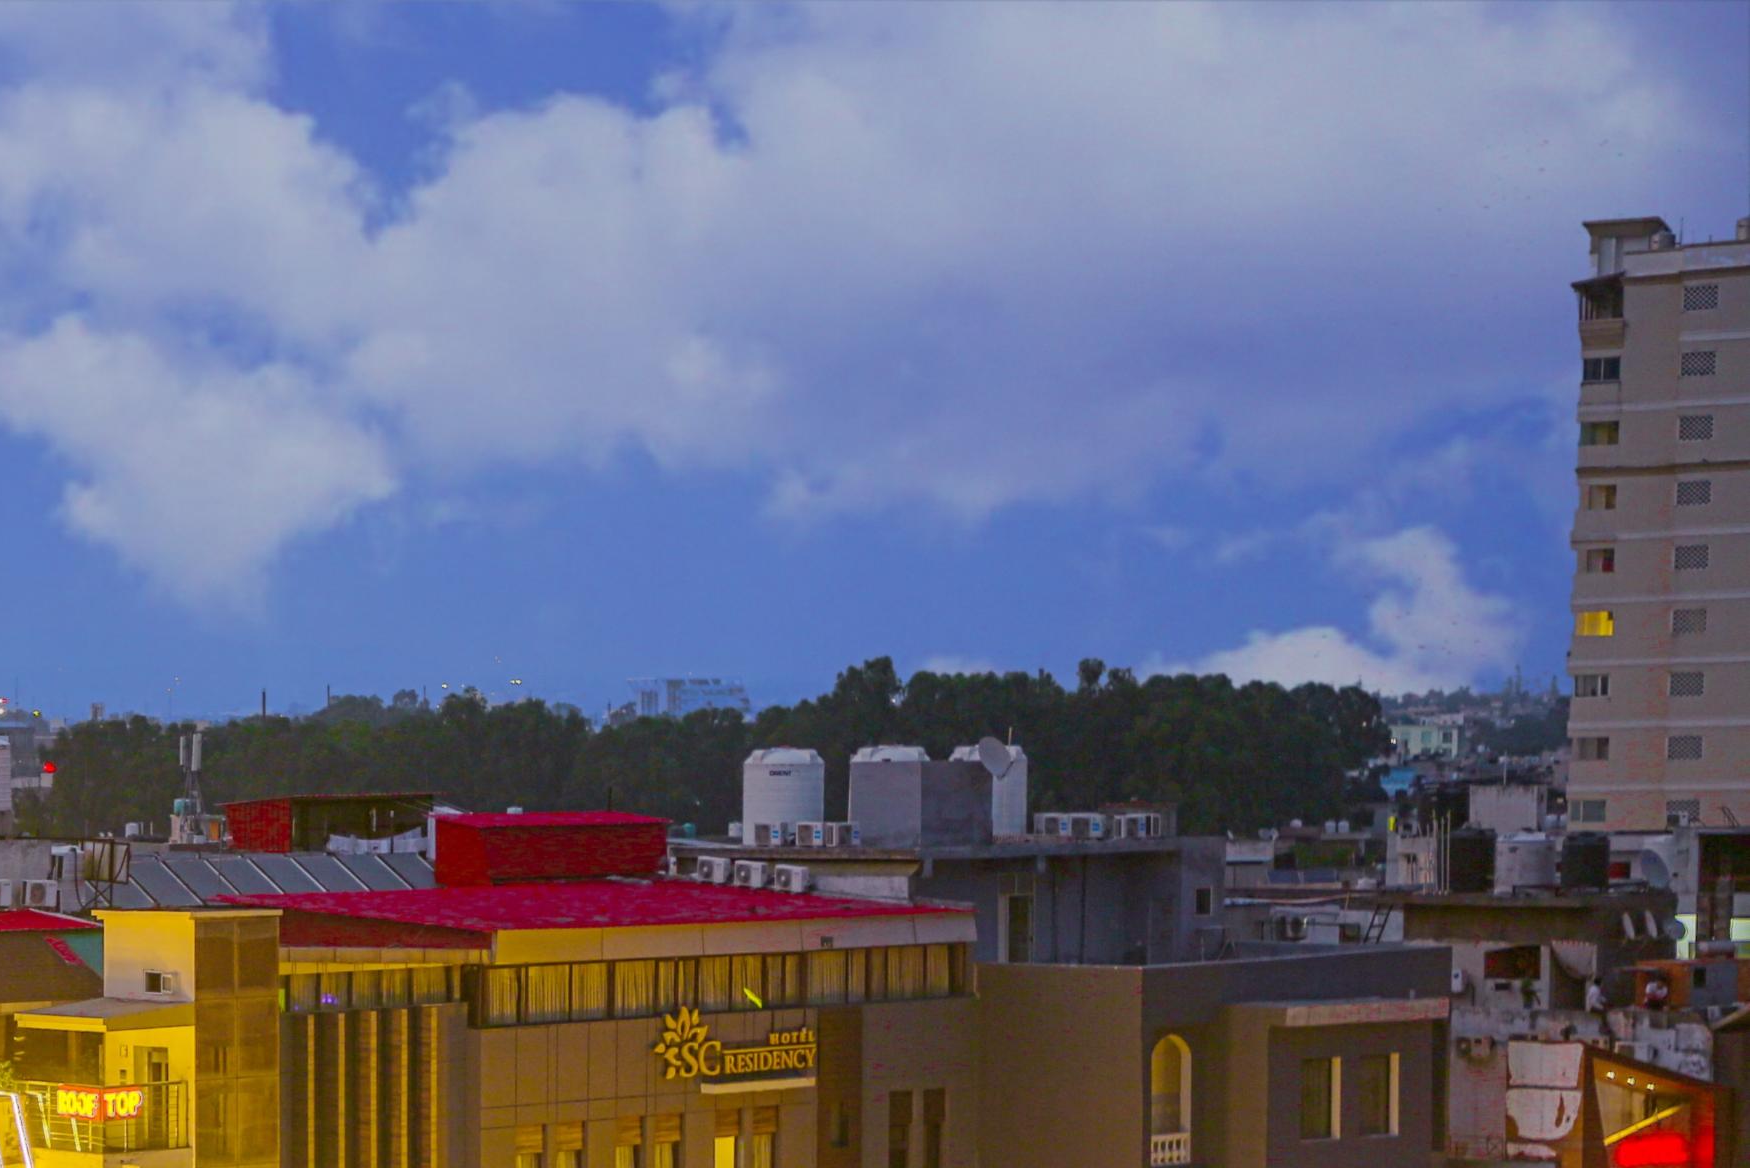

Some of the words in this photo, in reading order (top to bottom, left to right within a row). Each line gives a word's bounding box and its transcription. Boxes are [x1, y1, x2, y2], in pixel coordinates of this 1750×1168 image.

[769, 1028, 815, 1045] HOTEL
[679, 1041, 722, 1077] SC
[724, 1049, 816, 1074] RESIDENCY
[57, 1090, 99, 1117] ROOF
[104, 1090, 143, 1117] TOP
